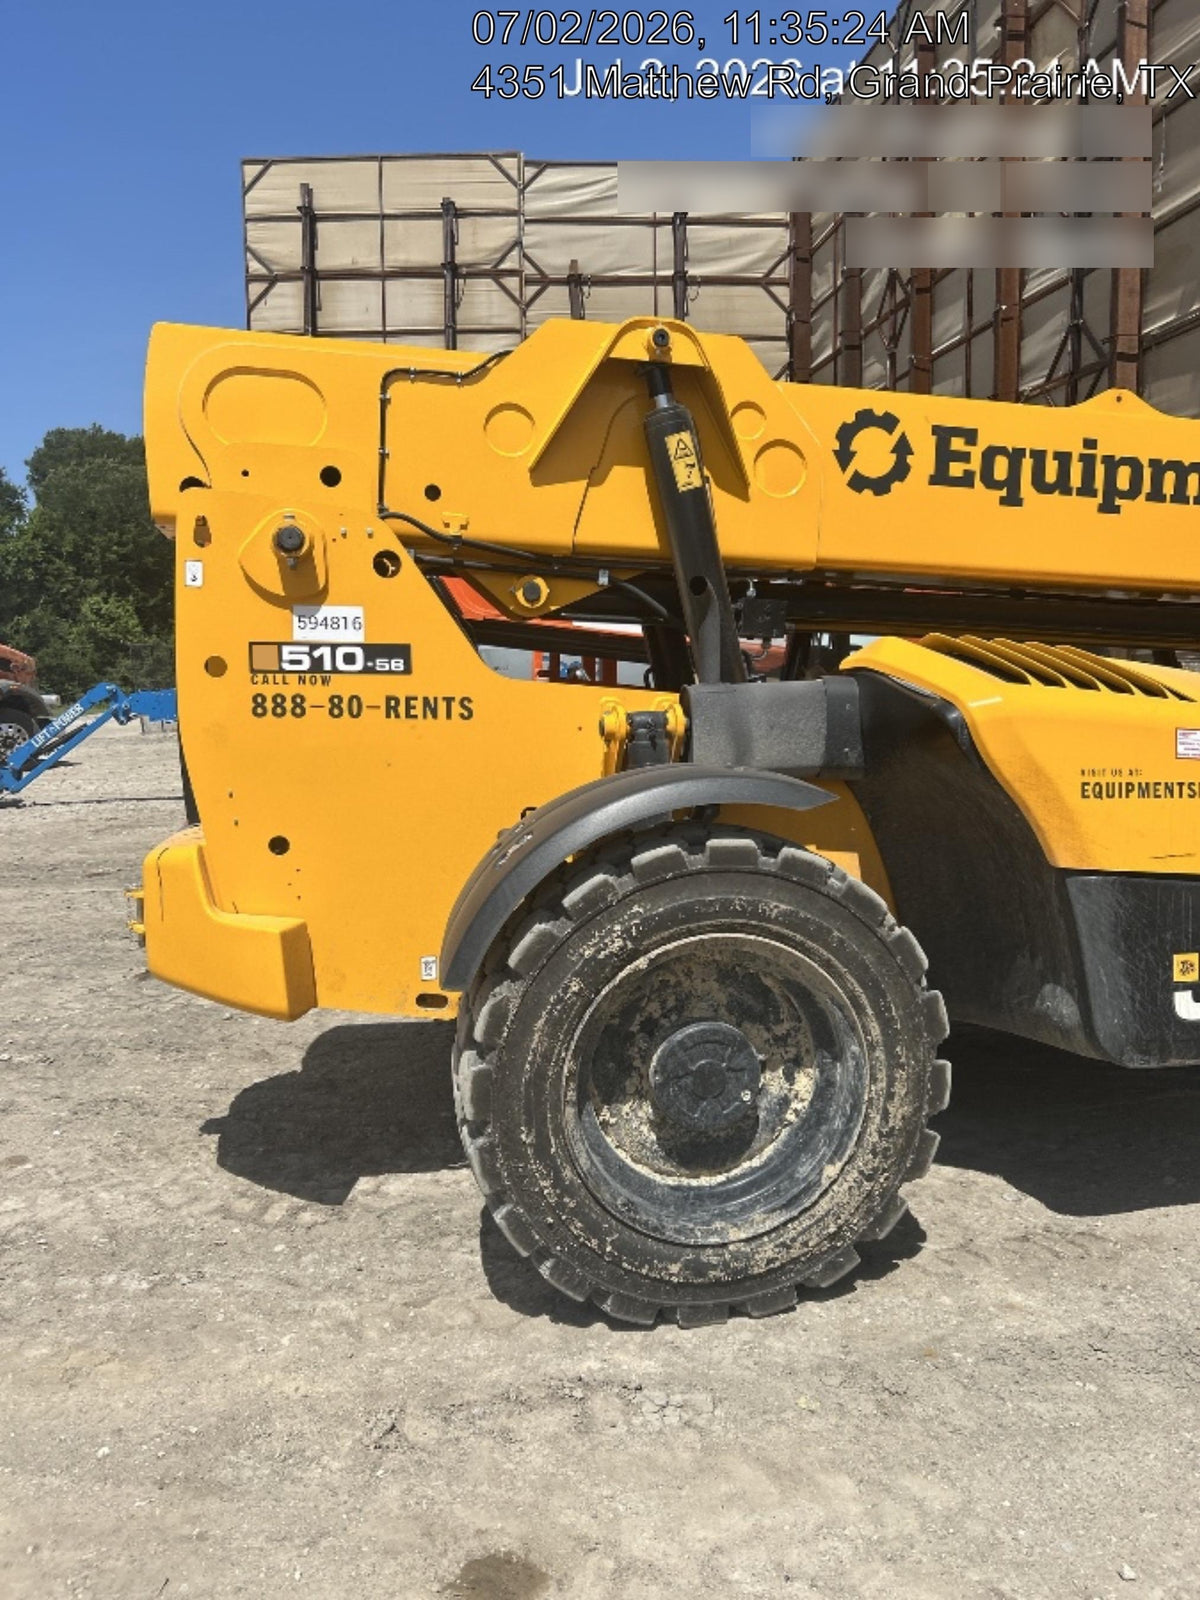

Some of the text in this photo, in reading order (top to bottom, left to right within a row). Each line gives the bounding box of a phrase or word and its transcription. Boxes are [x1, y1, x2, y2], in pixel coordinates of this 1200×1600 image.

[928, 424, 1200, 514] Equipm
[297, 614, 363, 631] 594816
[250, 674, 332, 687] CALL NOW
[251, 692, 474, 720] 888-80-RENTS
[31, 728, 51, 747] LIFT
[1080, 781, 1200, 800] EQUIPMENTS
